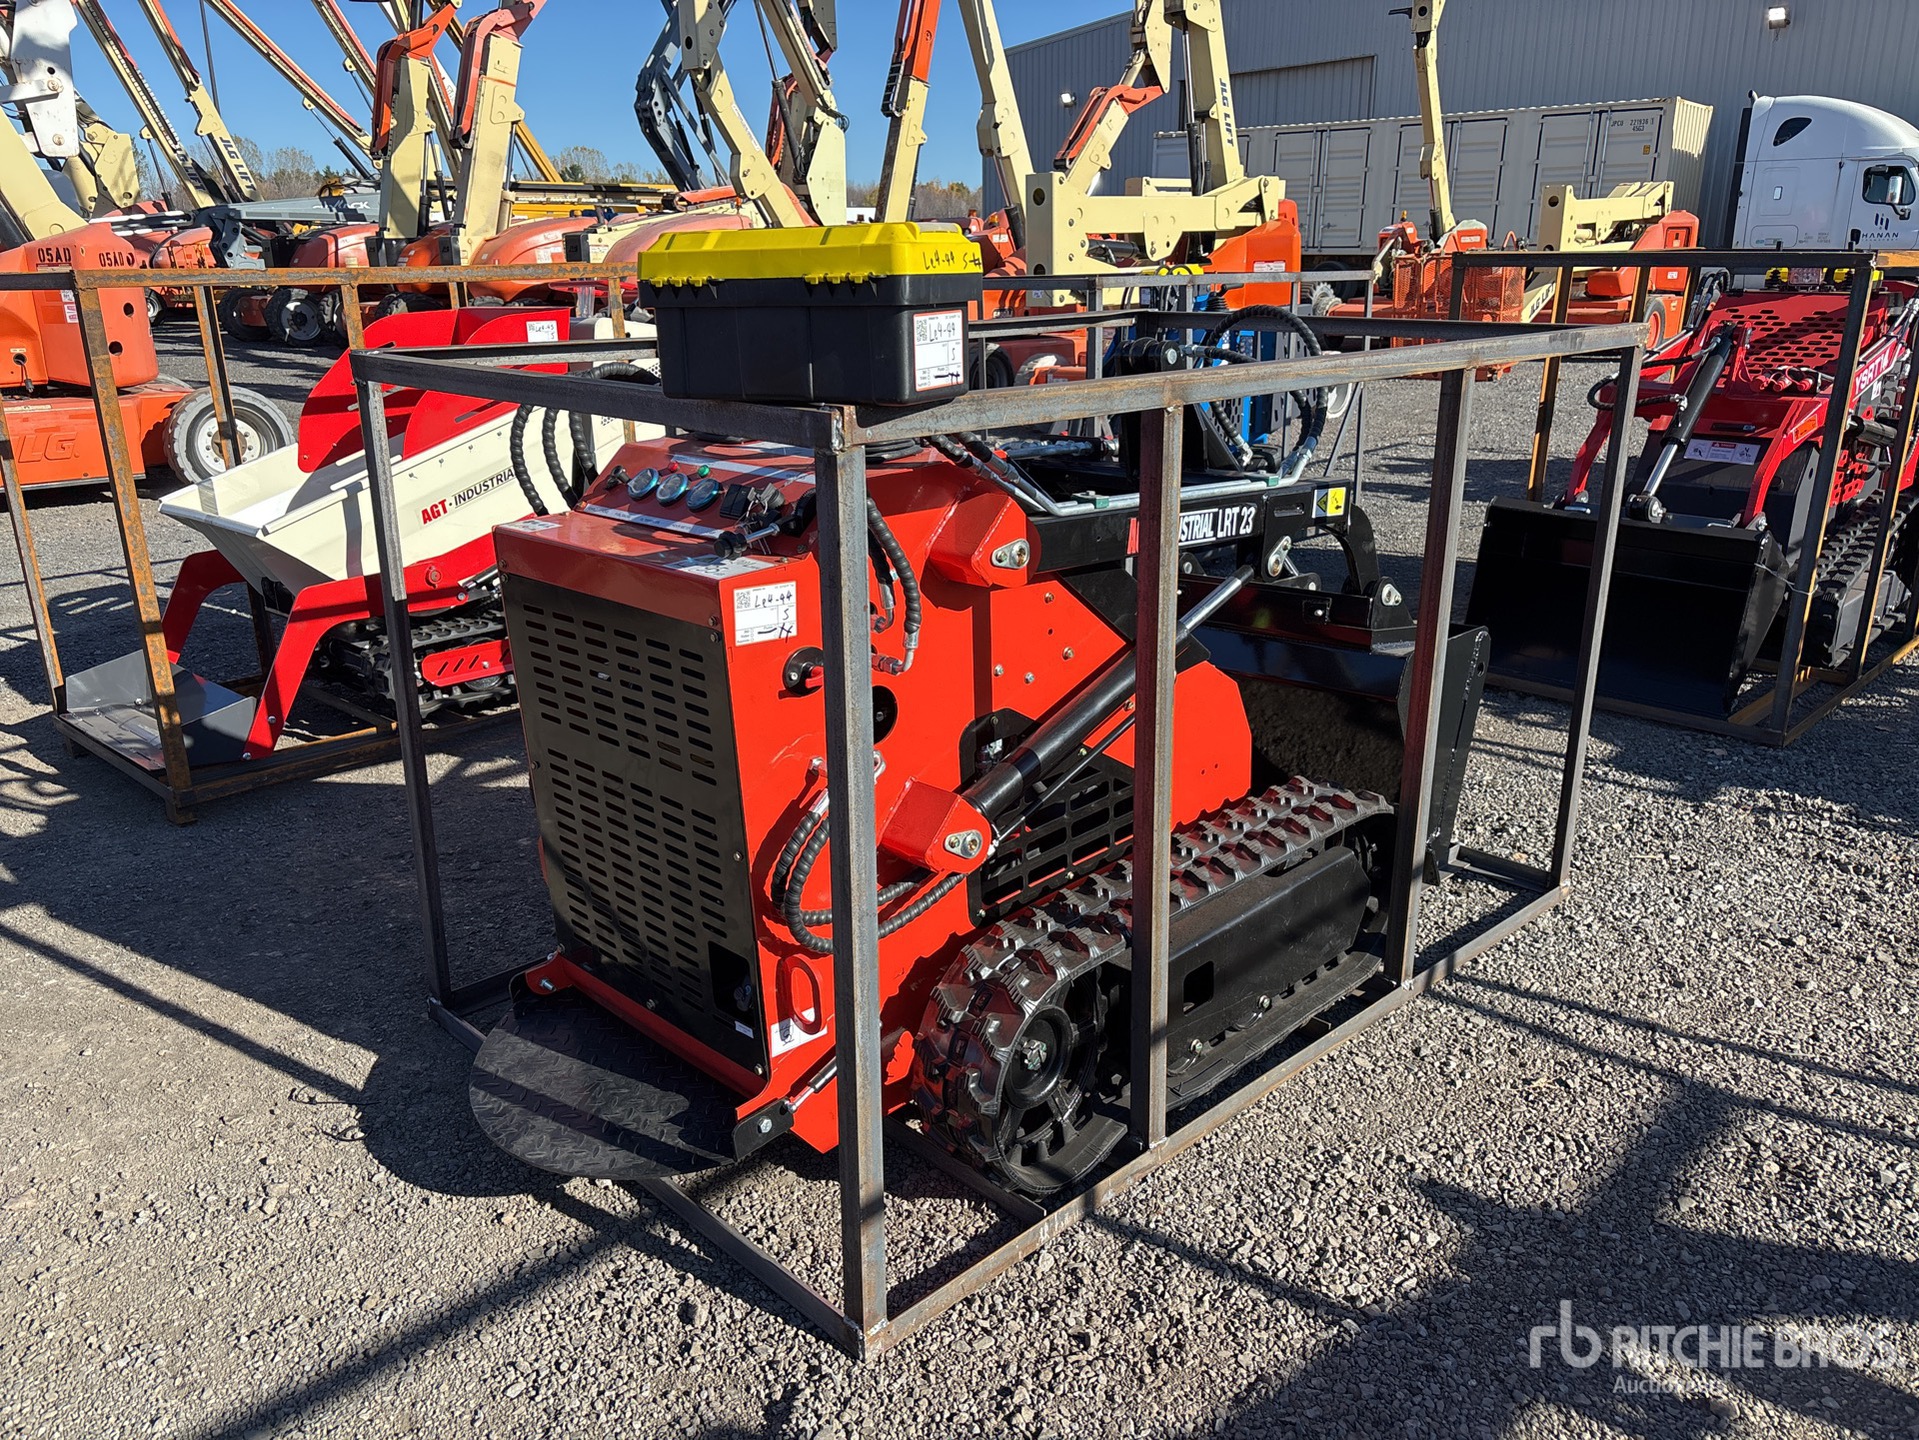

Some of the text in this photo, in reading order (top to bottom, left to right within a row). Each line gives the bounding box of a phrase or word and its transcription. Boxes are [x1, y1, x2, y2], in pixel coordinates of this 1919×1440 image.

[1219, 78, 1234, 147] JLG LIFT
[183, 166, 206, 191] LIFT
[219, 136, 257, 191] JLG LIFT
[421, 467, 515, 525] AGT INDUSTRIA
[1180, 505, 1256, 542] STRIAL LRT 23
